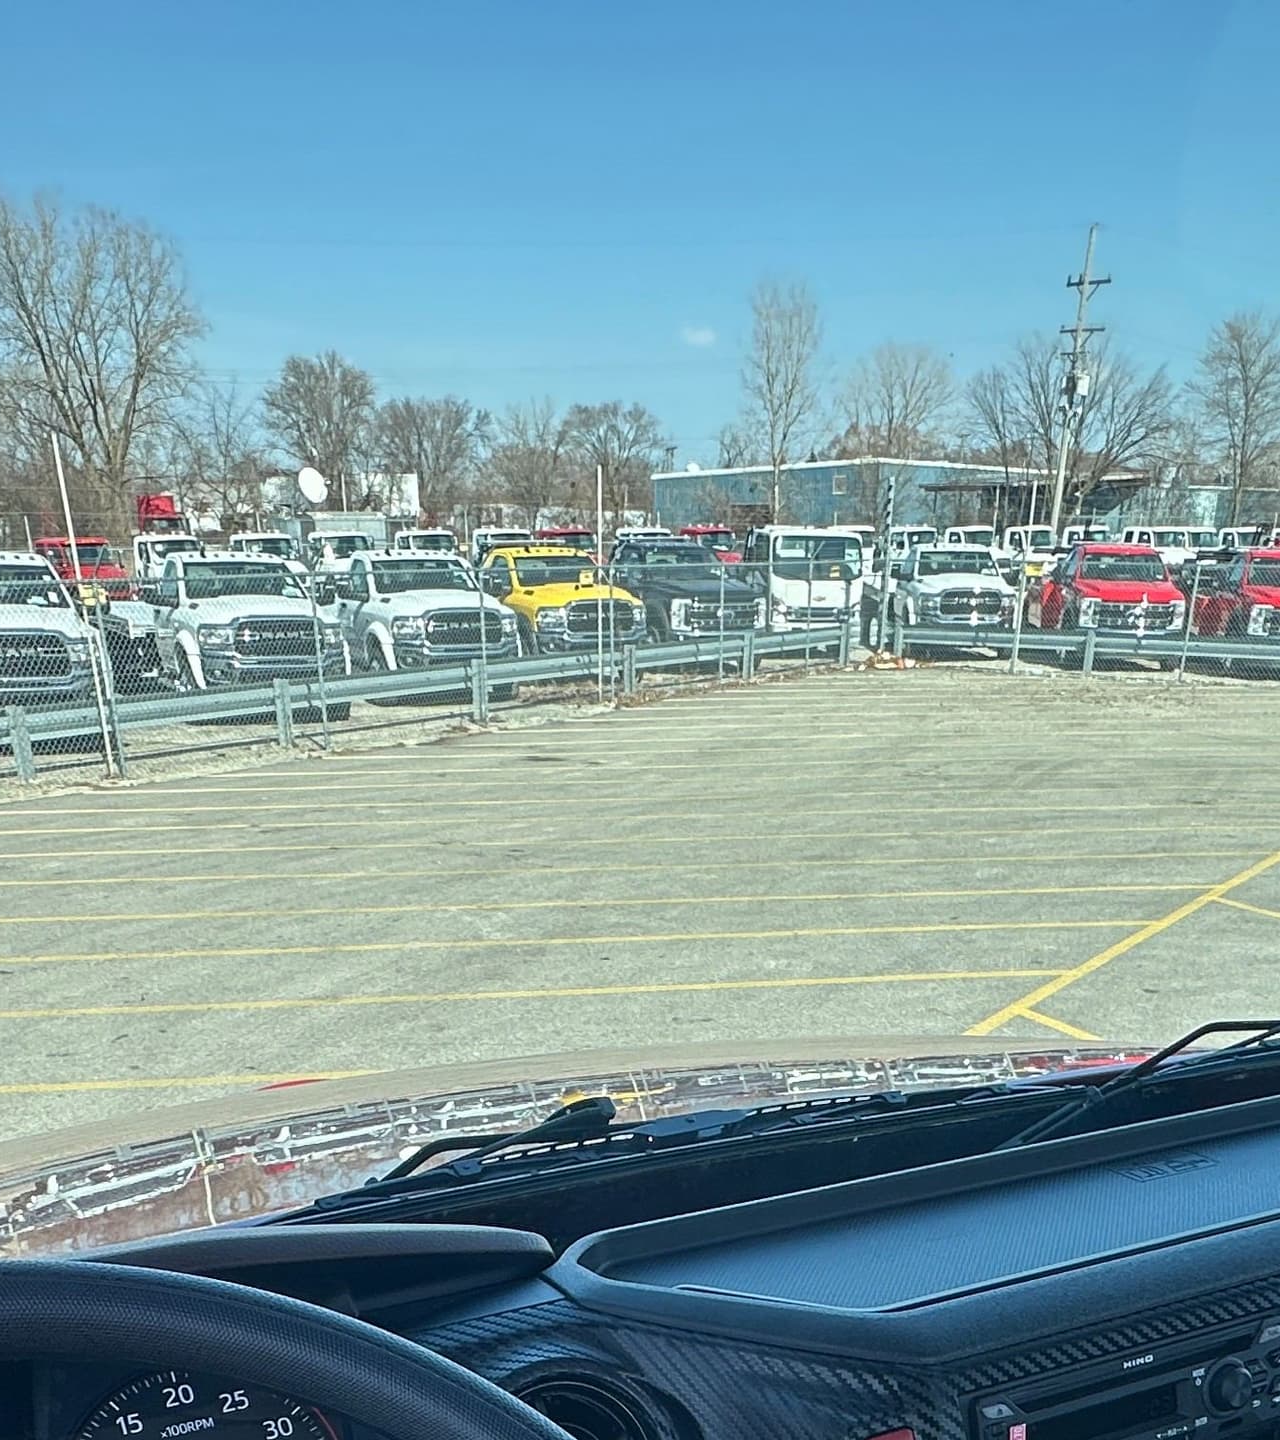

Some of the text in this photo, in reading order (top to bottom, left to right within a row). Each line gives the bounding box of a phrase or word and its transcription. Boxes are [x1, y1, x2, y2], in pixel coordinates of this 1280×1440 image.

[1123, 1354, 1153, 1368] HINO
[162, 1384, 194, 1408] 20
[219, 1390, 250, 1413] 25
[115, 1413, 144, 1436] 15
[262, 1417, 294, 1440] 30
